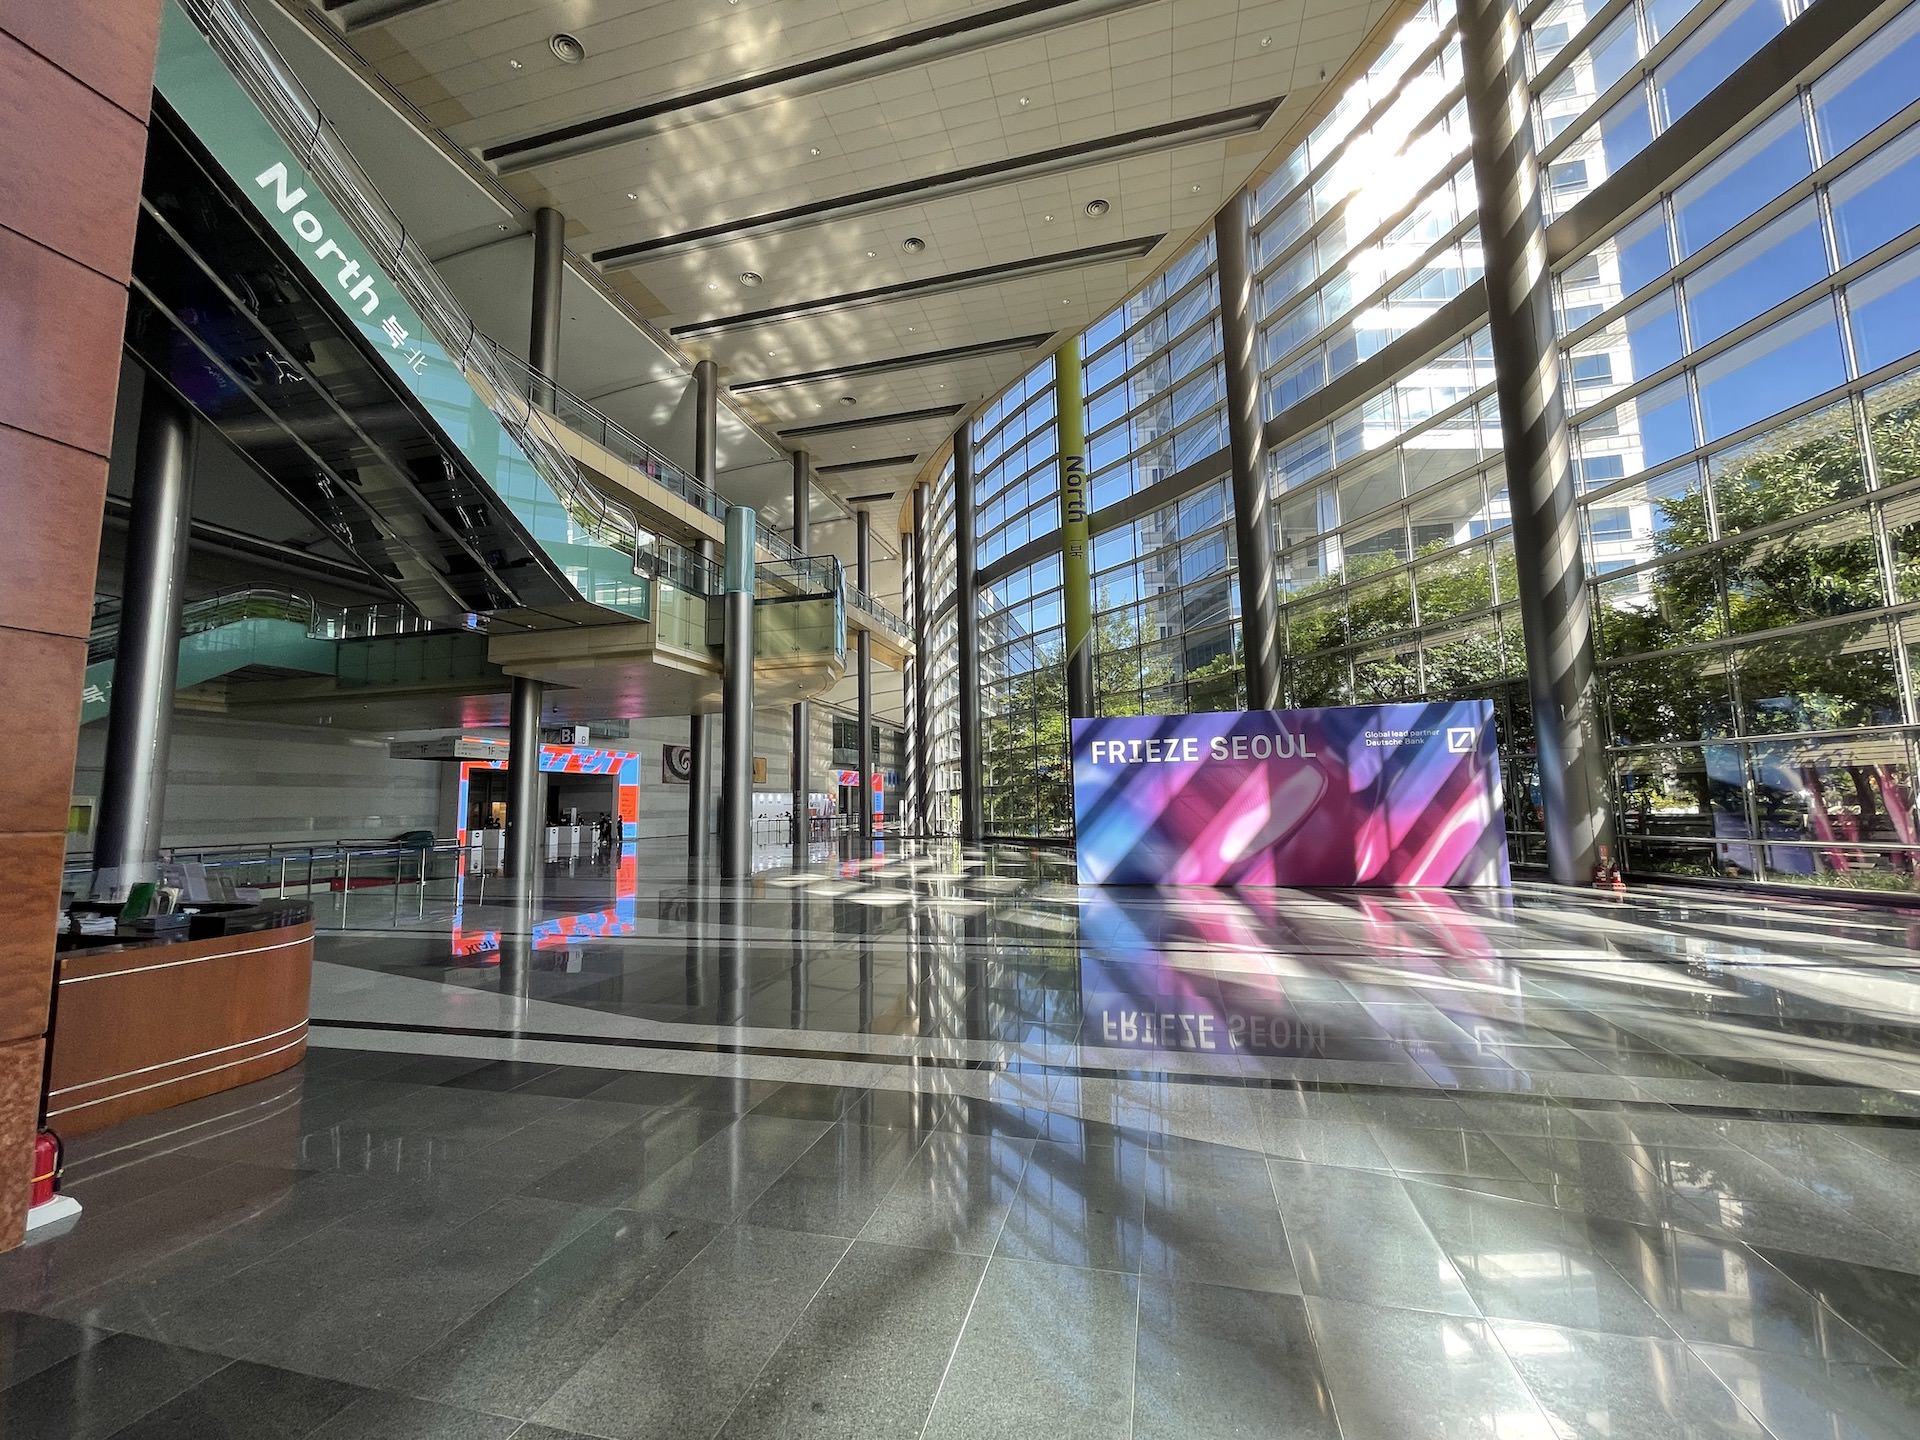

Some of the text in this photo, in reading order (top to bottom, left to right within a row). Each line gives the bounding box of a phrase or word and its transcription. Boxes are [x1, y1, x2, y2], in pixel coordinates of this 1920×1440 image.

[254, 161, 380, 316] North
[382, 314, 409, 349] 북
[403, 347, 428, 375] 北
[1066, 456, 1087, 523] North
[561, 728, 575, 743] B1
[1090, 733, 1318, 764] FRIEZE SEOUL
[1364, 729, 1441, 739] Global lead partner
[1365, 737, 1425, 747] Deutsche Bank
